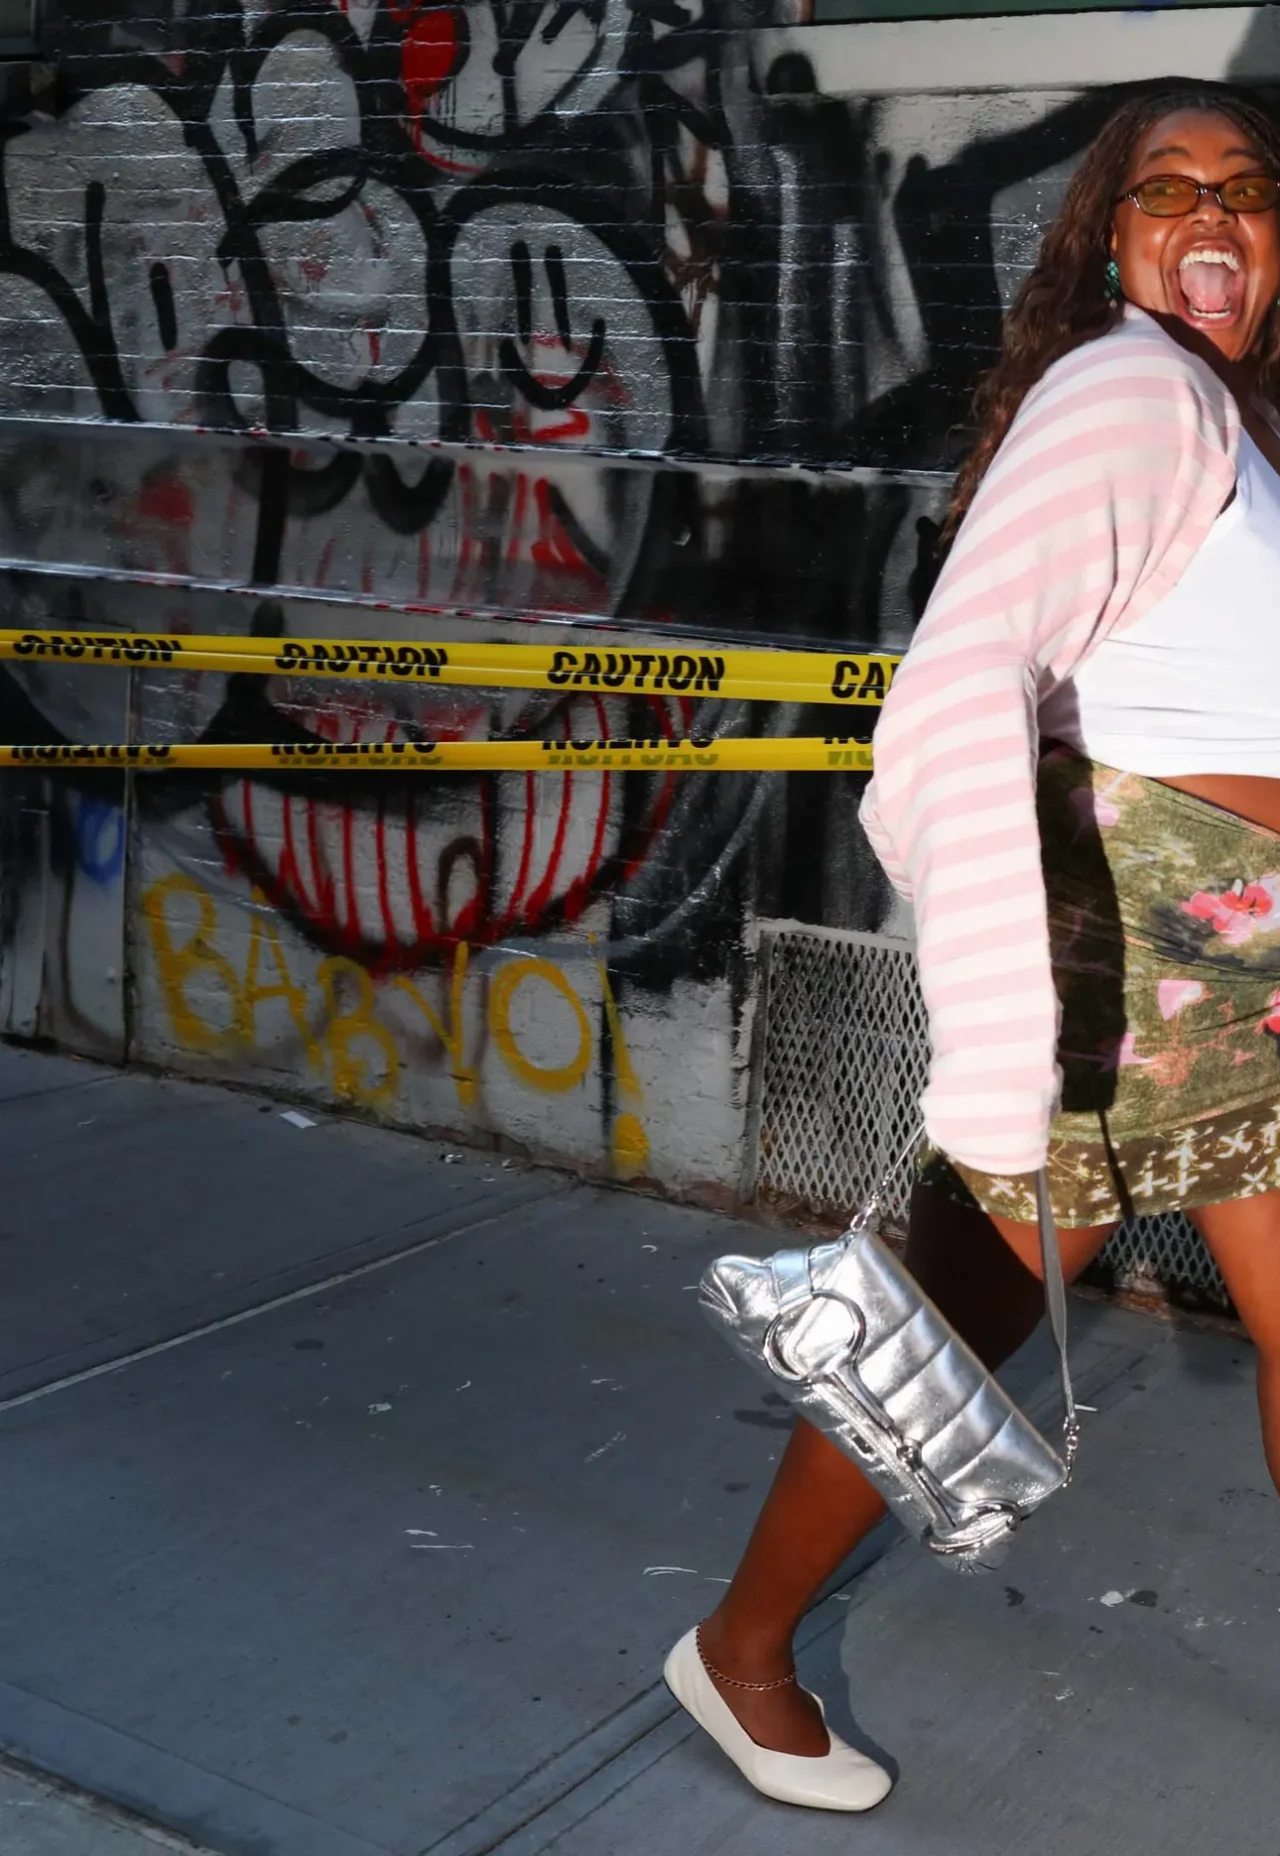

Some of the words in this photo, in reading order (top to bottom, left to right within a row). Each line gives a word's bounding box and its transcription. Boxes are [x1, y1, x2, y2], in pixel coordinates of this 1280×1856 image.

[13, 635, 182, 662] CAUTION
[275, 644, 447, 676] CAUTION
[547, 652, 725, 691] CAUTION
